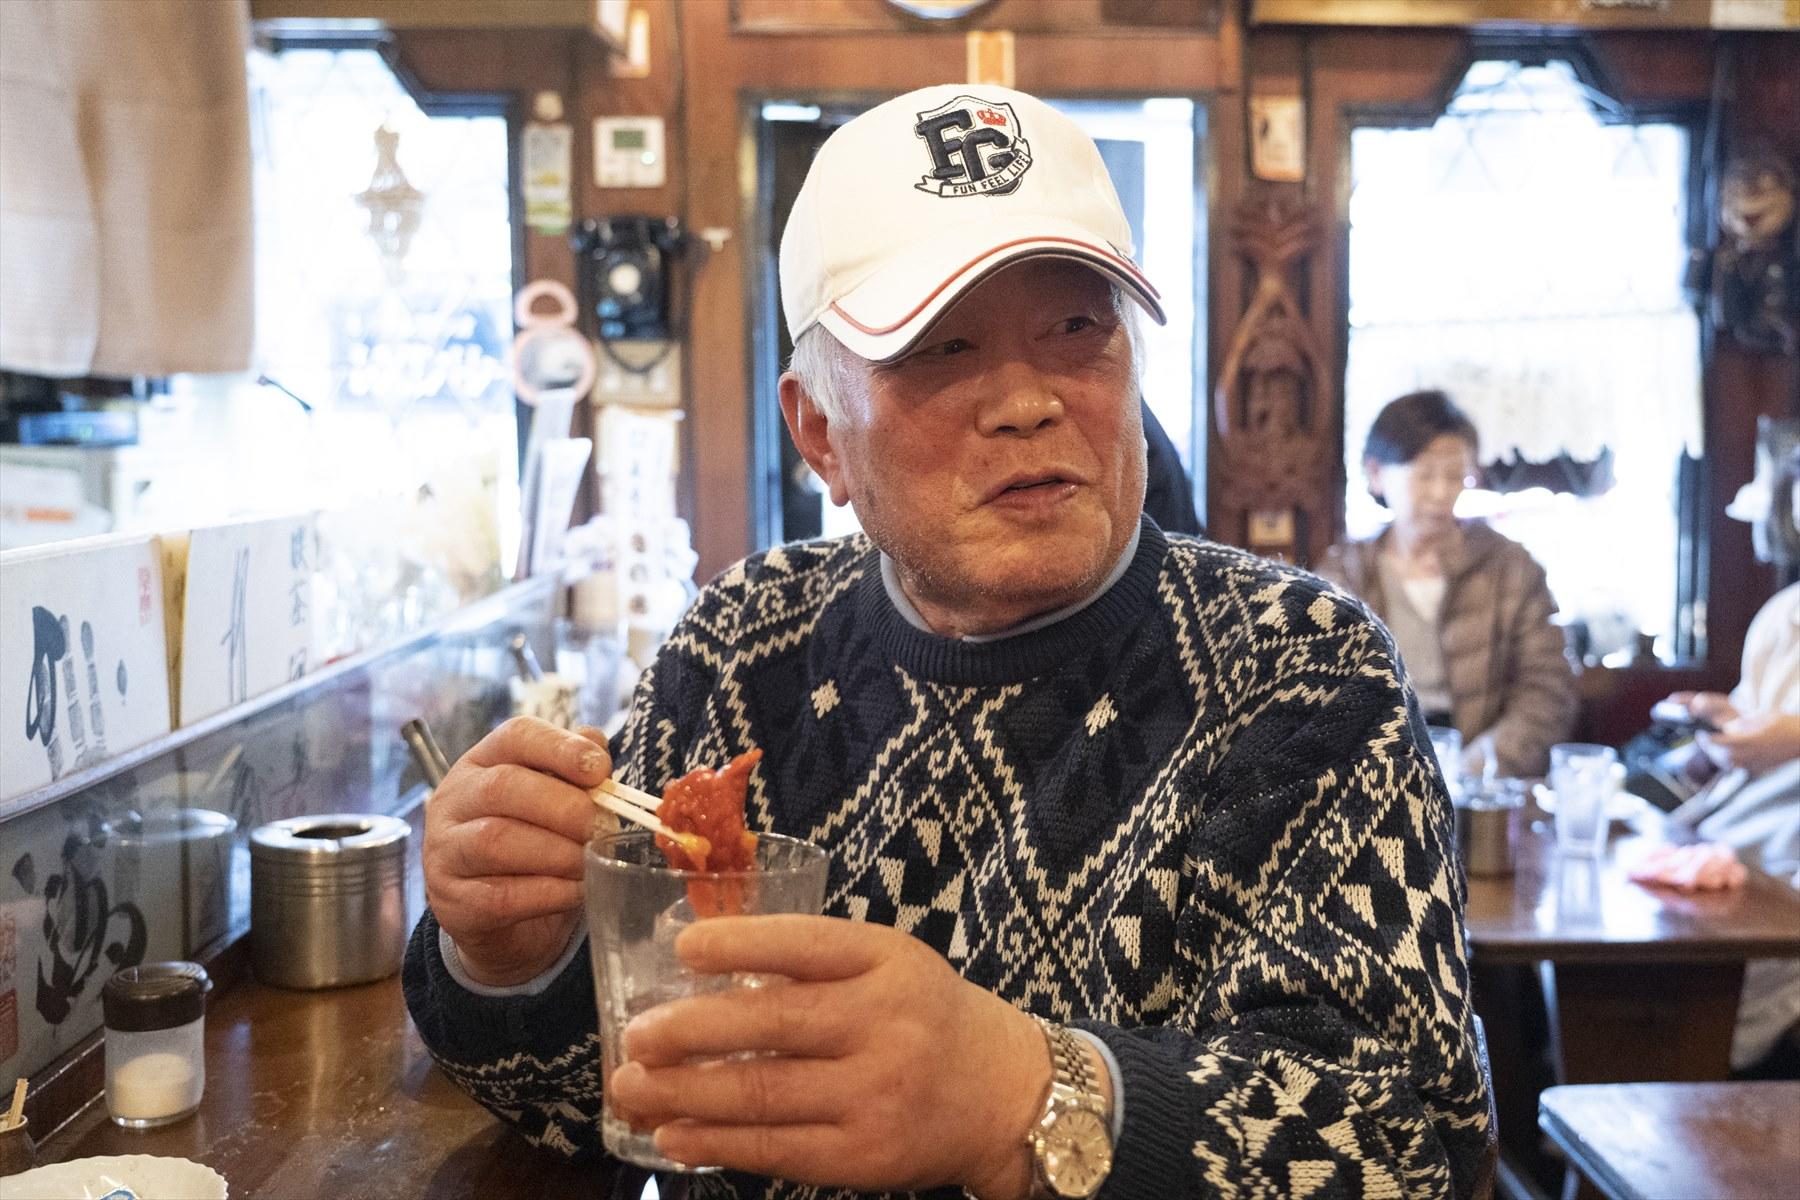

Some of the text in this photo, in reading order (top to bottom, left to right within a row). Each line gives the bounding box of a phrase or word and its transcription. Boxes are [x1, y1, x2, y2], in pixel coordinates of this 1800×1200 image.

[952, 154, 1031, 195] FUN FEEL LIFE
